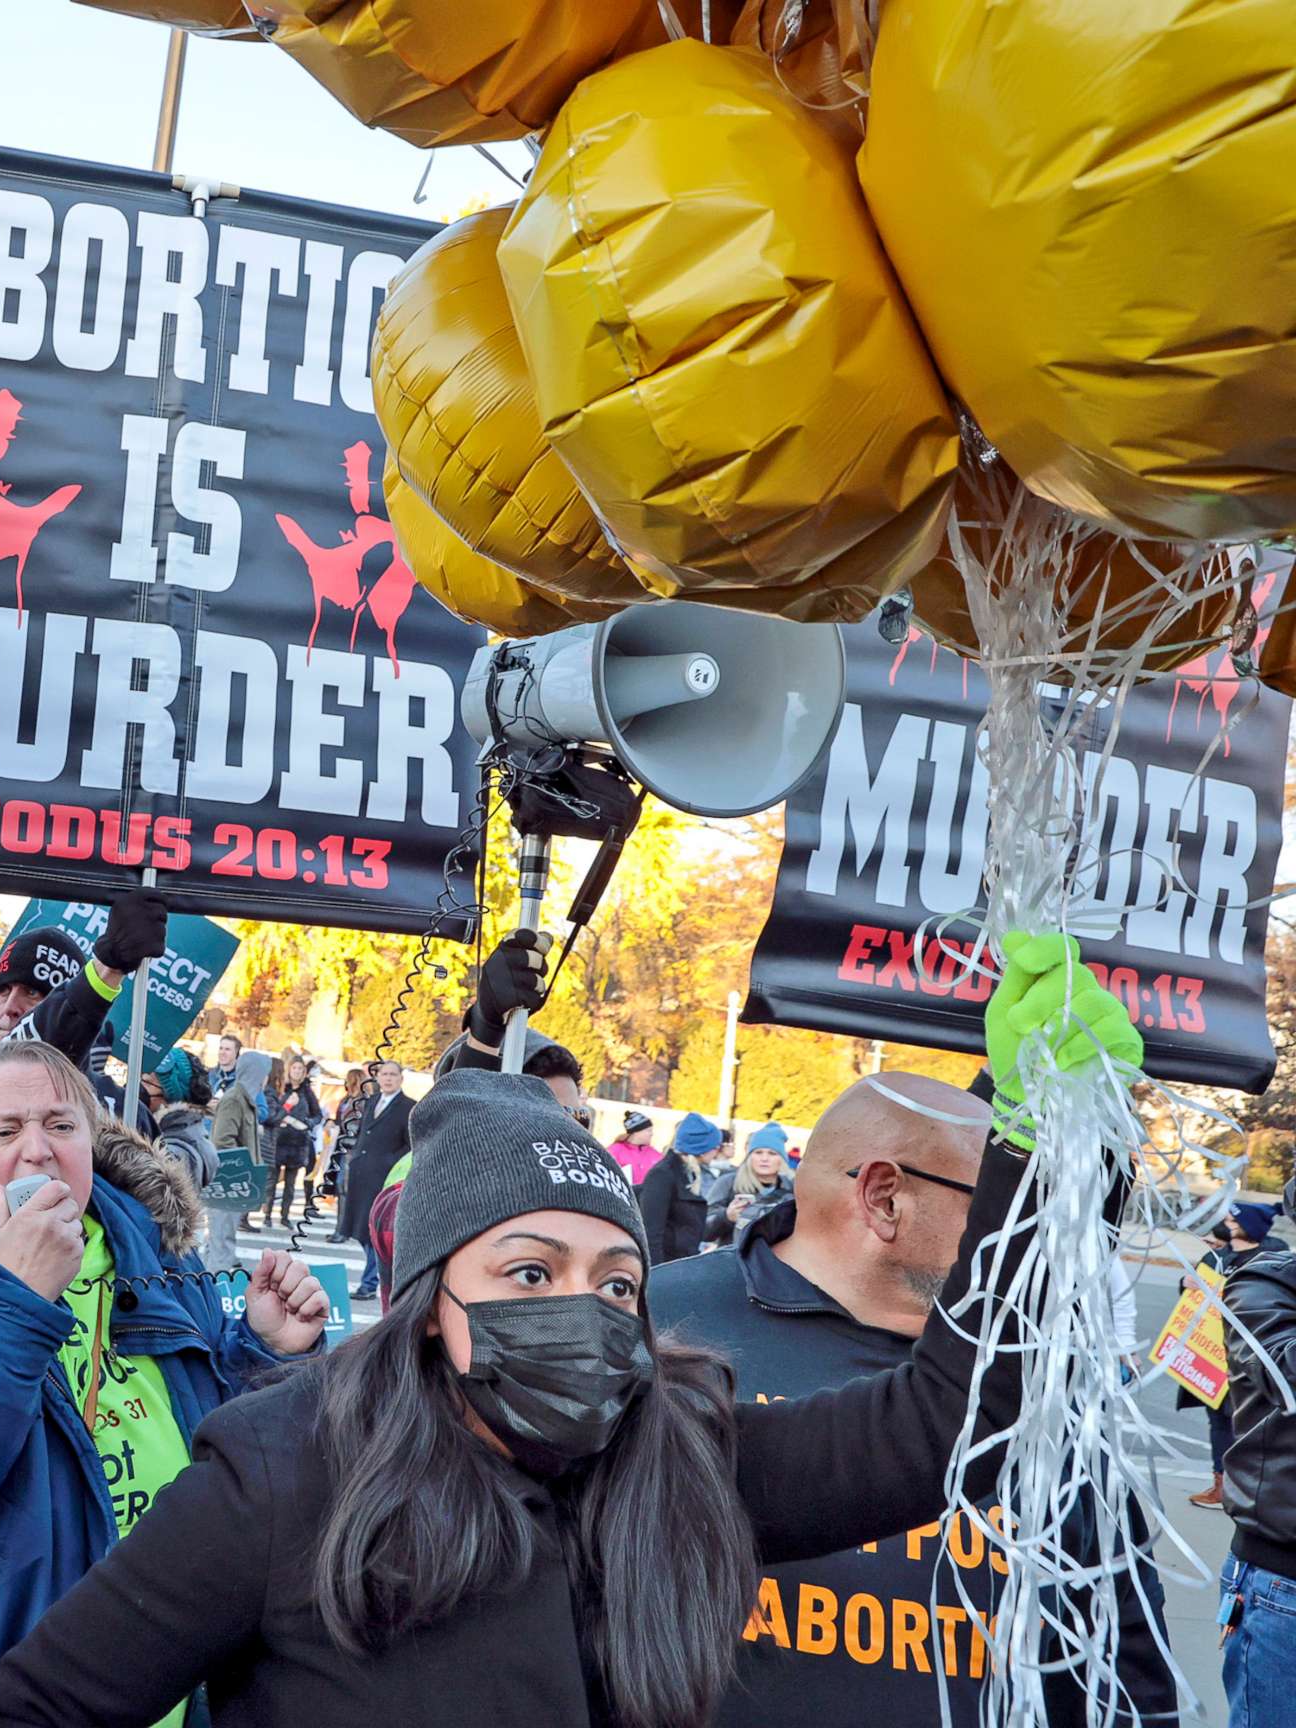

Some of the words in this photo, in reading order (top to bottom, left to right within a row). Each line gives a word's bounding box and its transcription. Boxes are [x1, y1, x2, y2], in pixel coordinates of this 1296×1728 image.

[109, 414, 247, 592] IS
[211, 823, 392, 889] 20:13
[33, 962, 72, 988] GO
[147, 976, 194, 1013] CCESS
[1086, 962, 1206, 1034] 0:13
[532, 1139, 602, 1163] BANS
[539, 1155, 590, 1170] OFF
